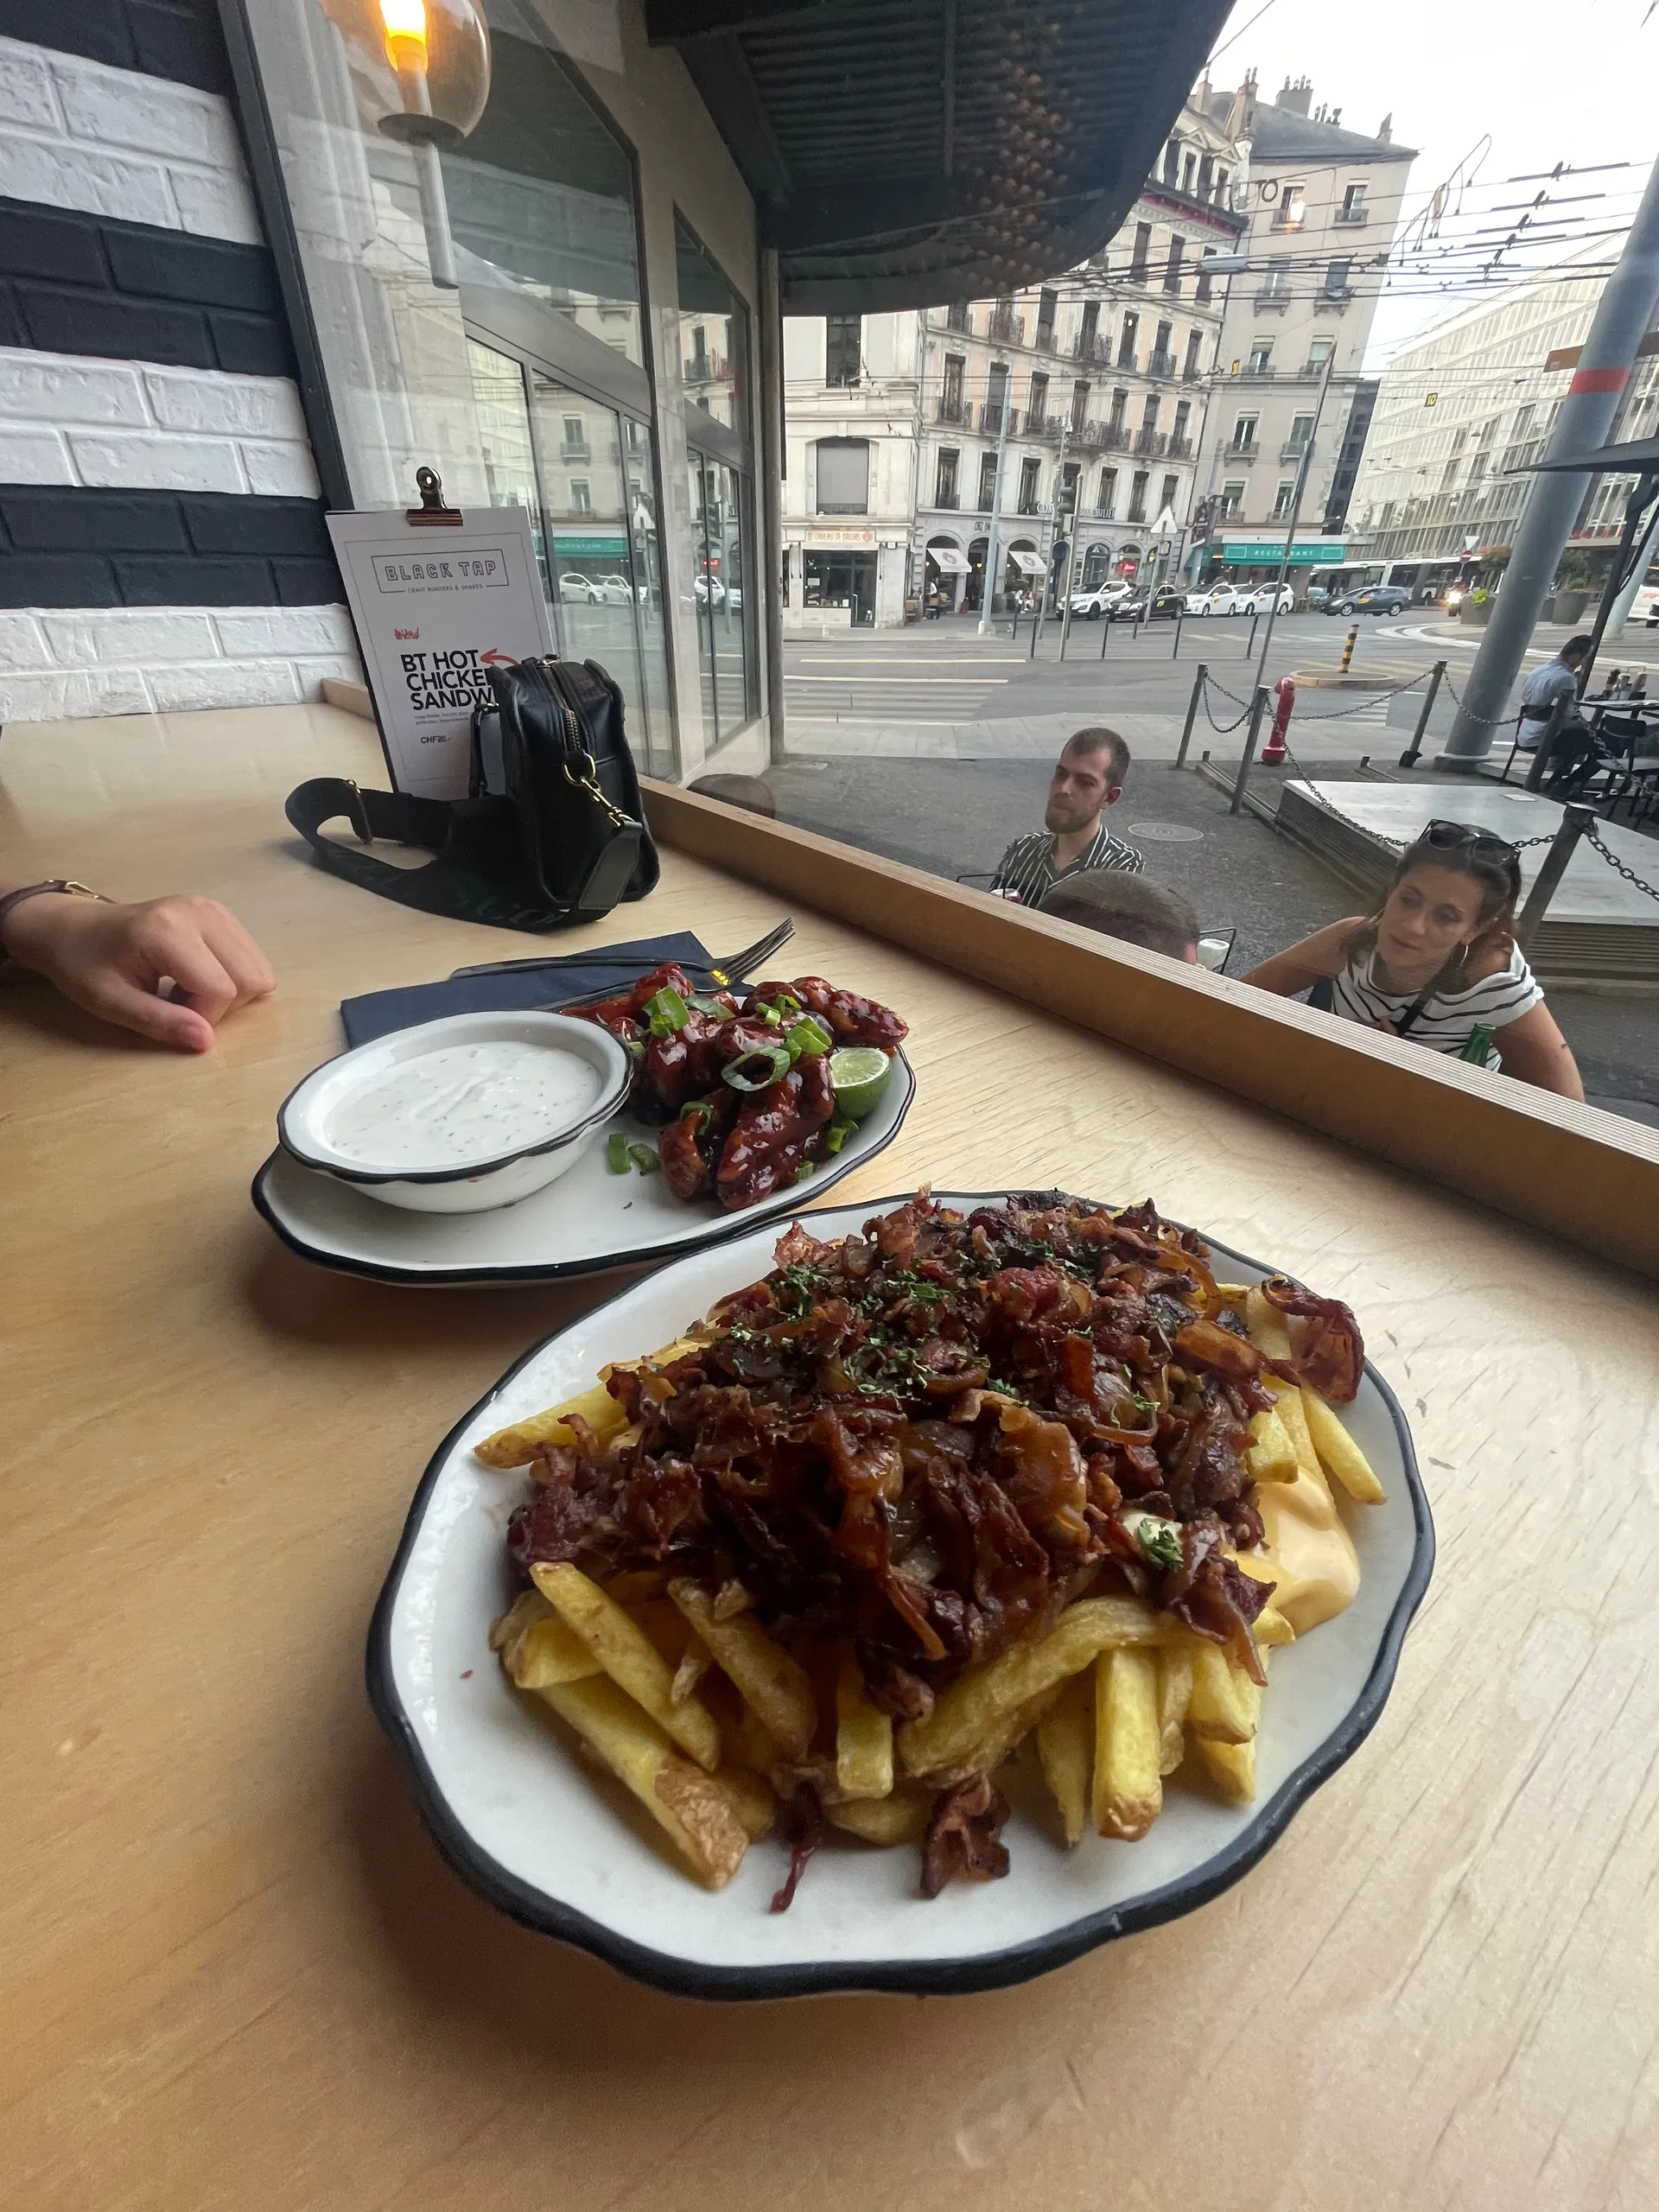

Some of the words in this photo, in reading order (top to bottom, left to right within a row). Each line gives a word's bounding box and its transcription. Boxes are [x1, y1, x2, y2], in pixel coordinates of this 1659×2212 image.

[1427, 394, 1436, 405] 10
[385, 563, 454, 581] BLACK
[458, 560, 496, 576] TAP
[400, 652, 427, 672] BT
[432, 650, 479, 670] HOT
[410, 687, 493, 710] SANDW
